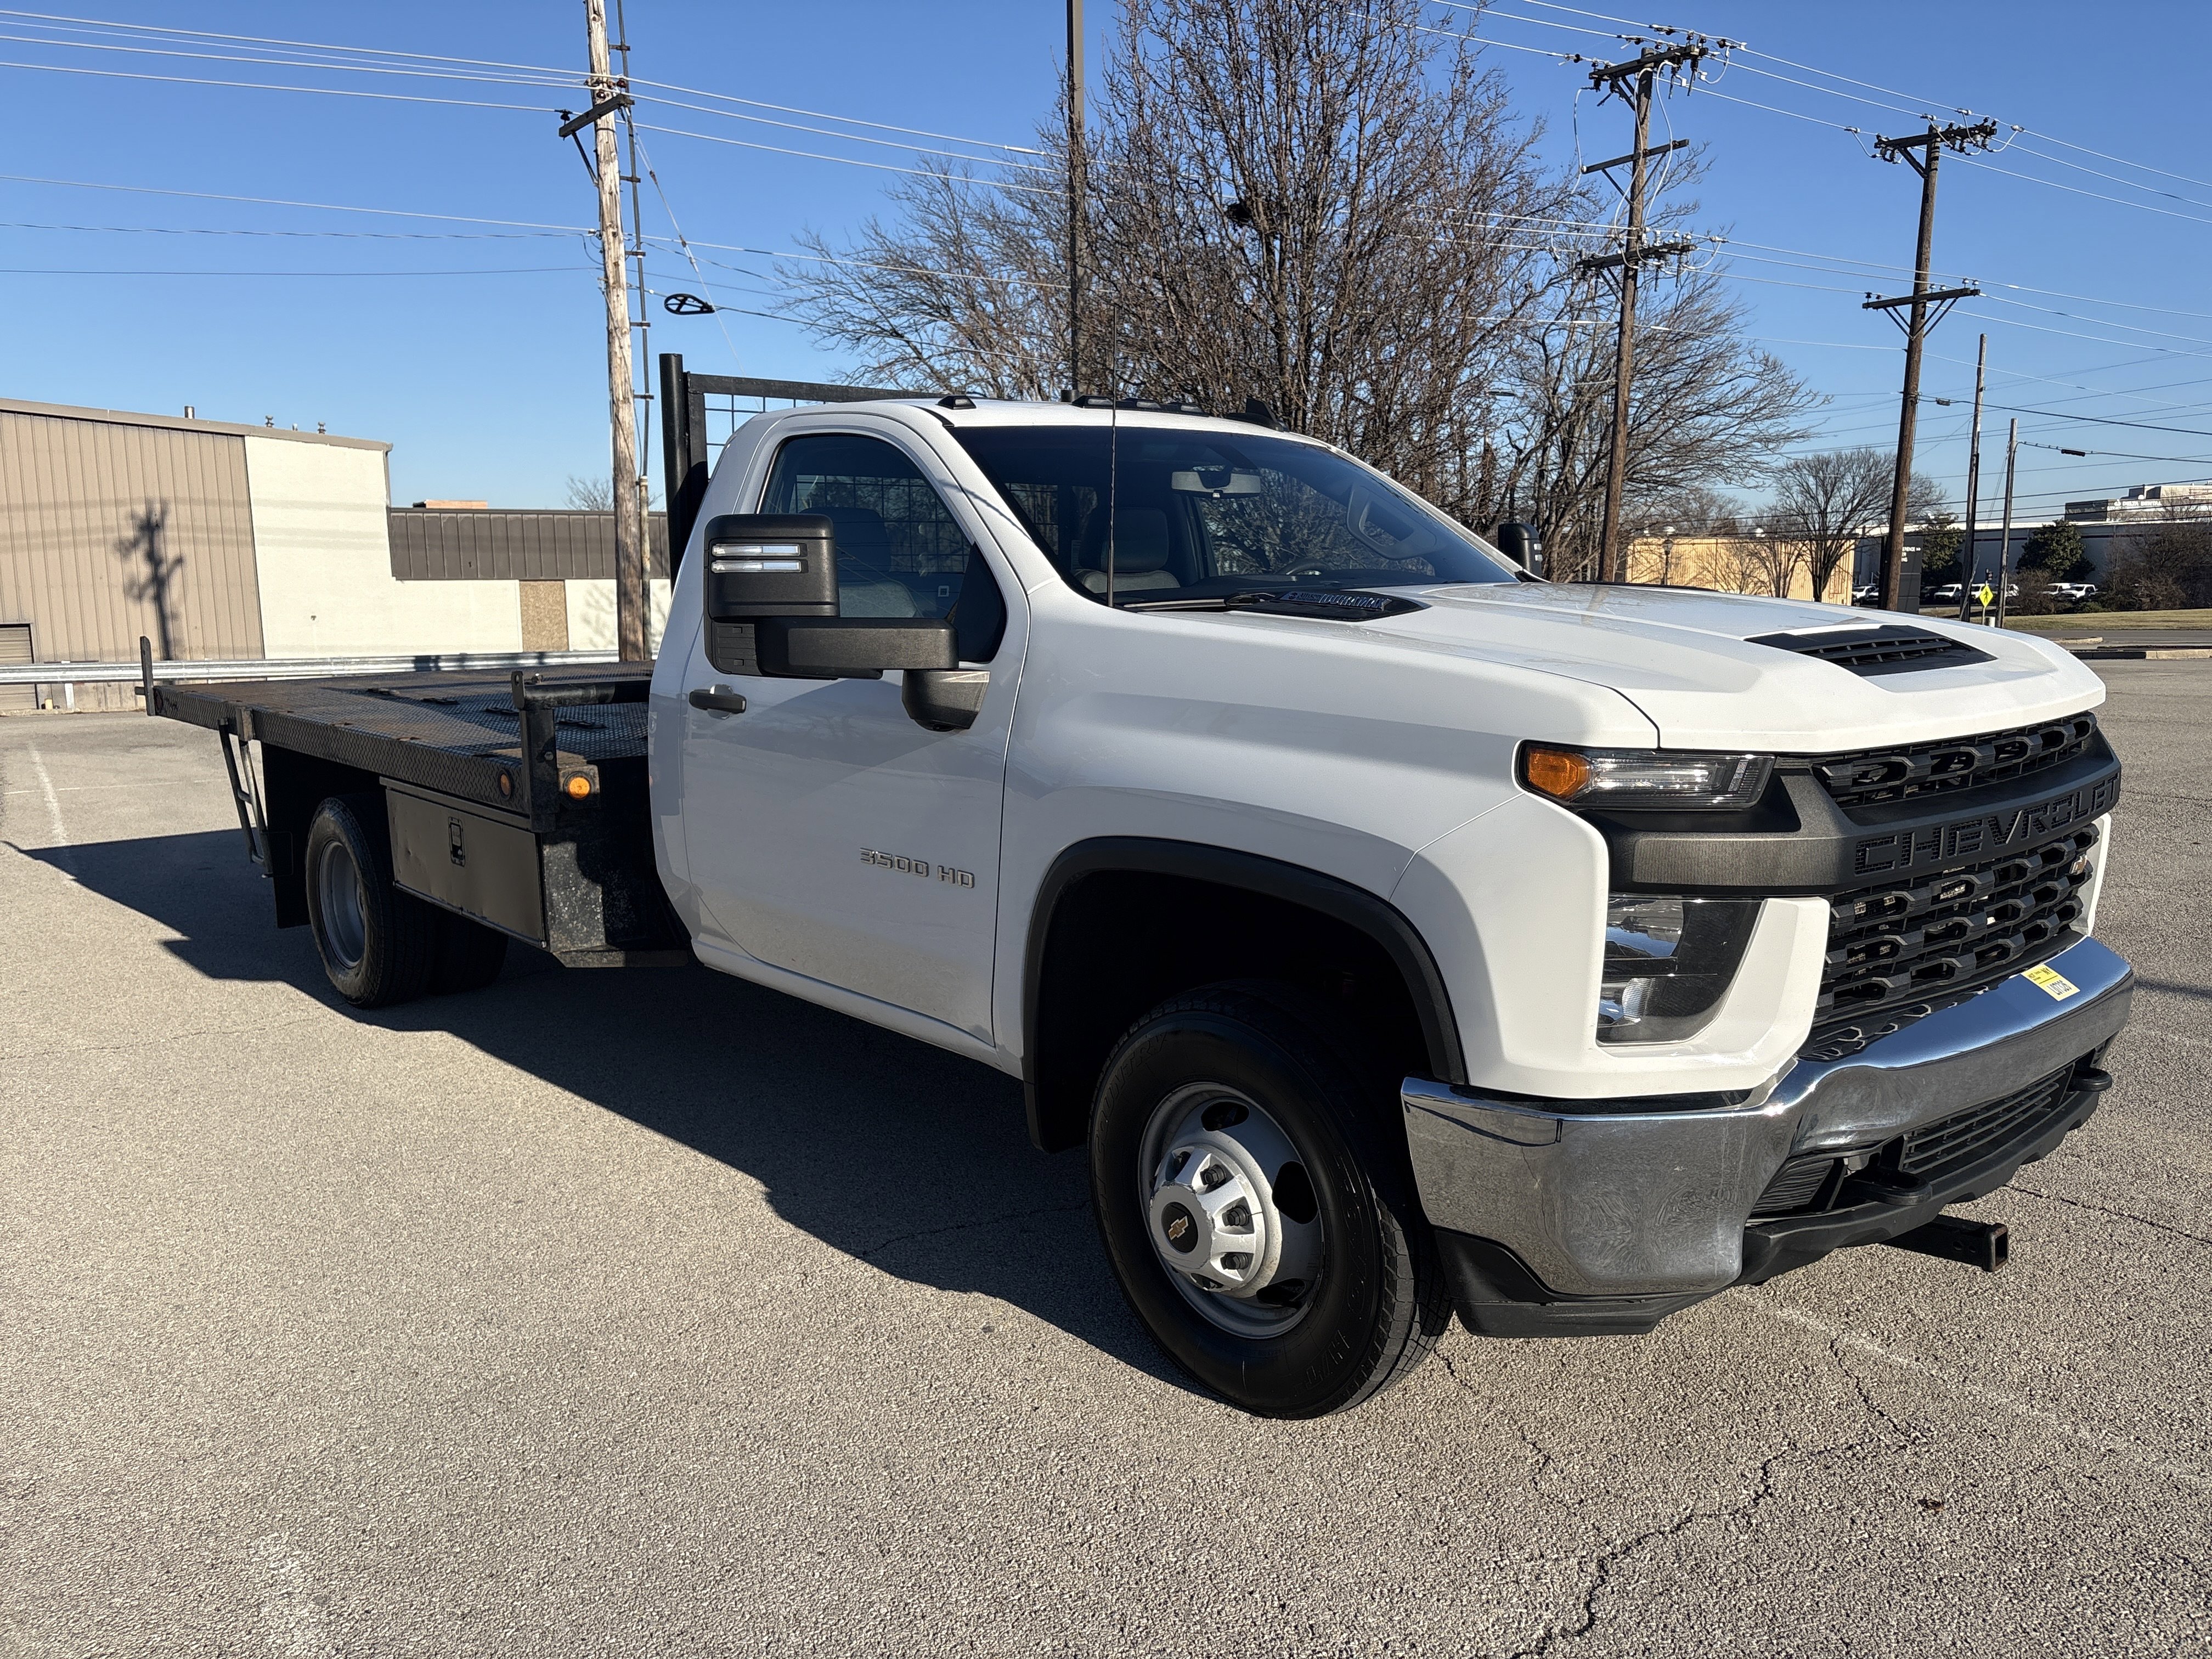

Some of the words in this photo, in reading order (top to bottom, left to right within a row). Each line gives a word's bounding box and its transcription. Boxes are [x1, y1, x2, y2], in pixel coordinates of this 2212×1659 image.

[859, 847, 929, 877] 3500
[937, 865, 975, 889] HD
[1854, 773, 2119, 875] CHEVROLET
[1095, 1032, 1167, 1164] COUNTRY
